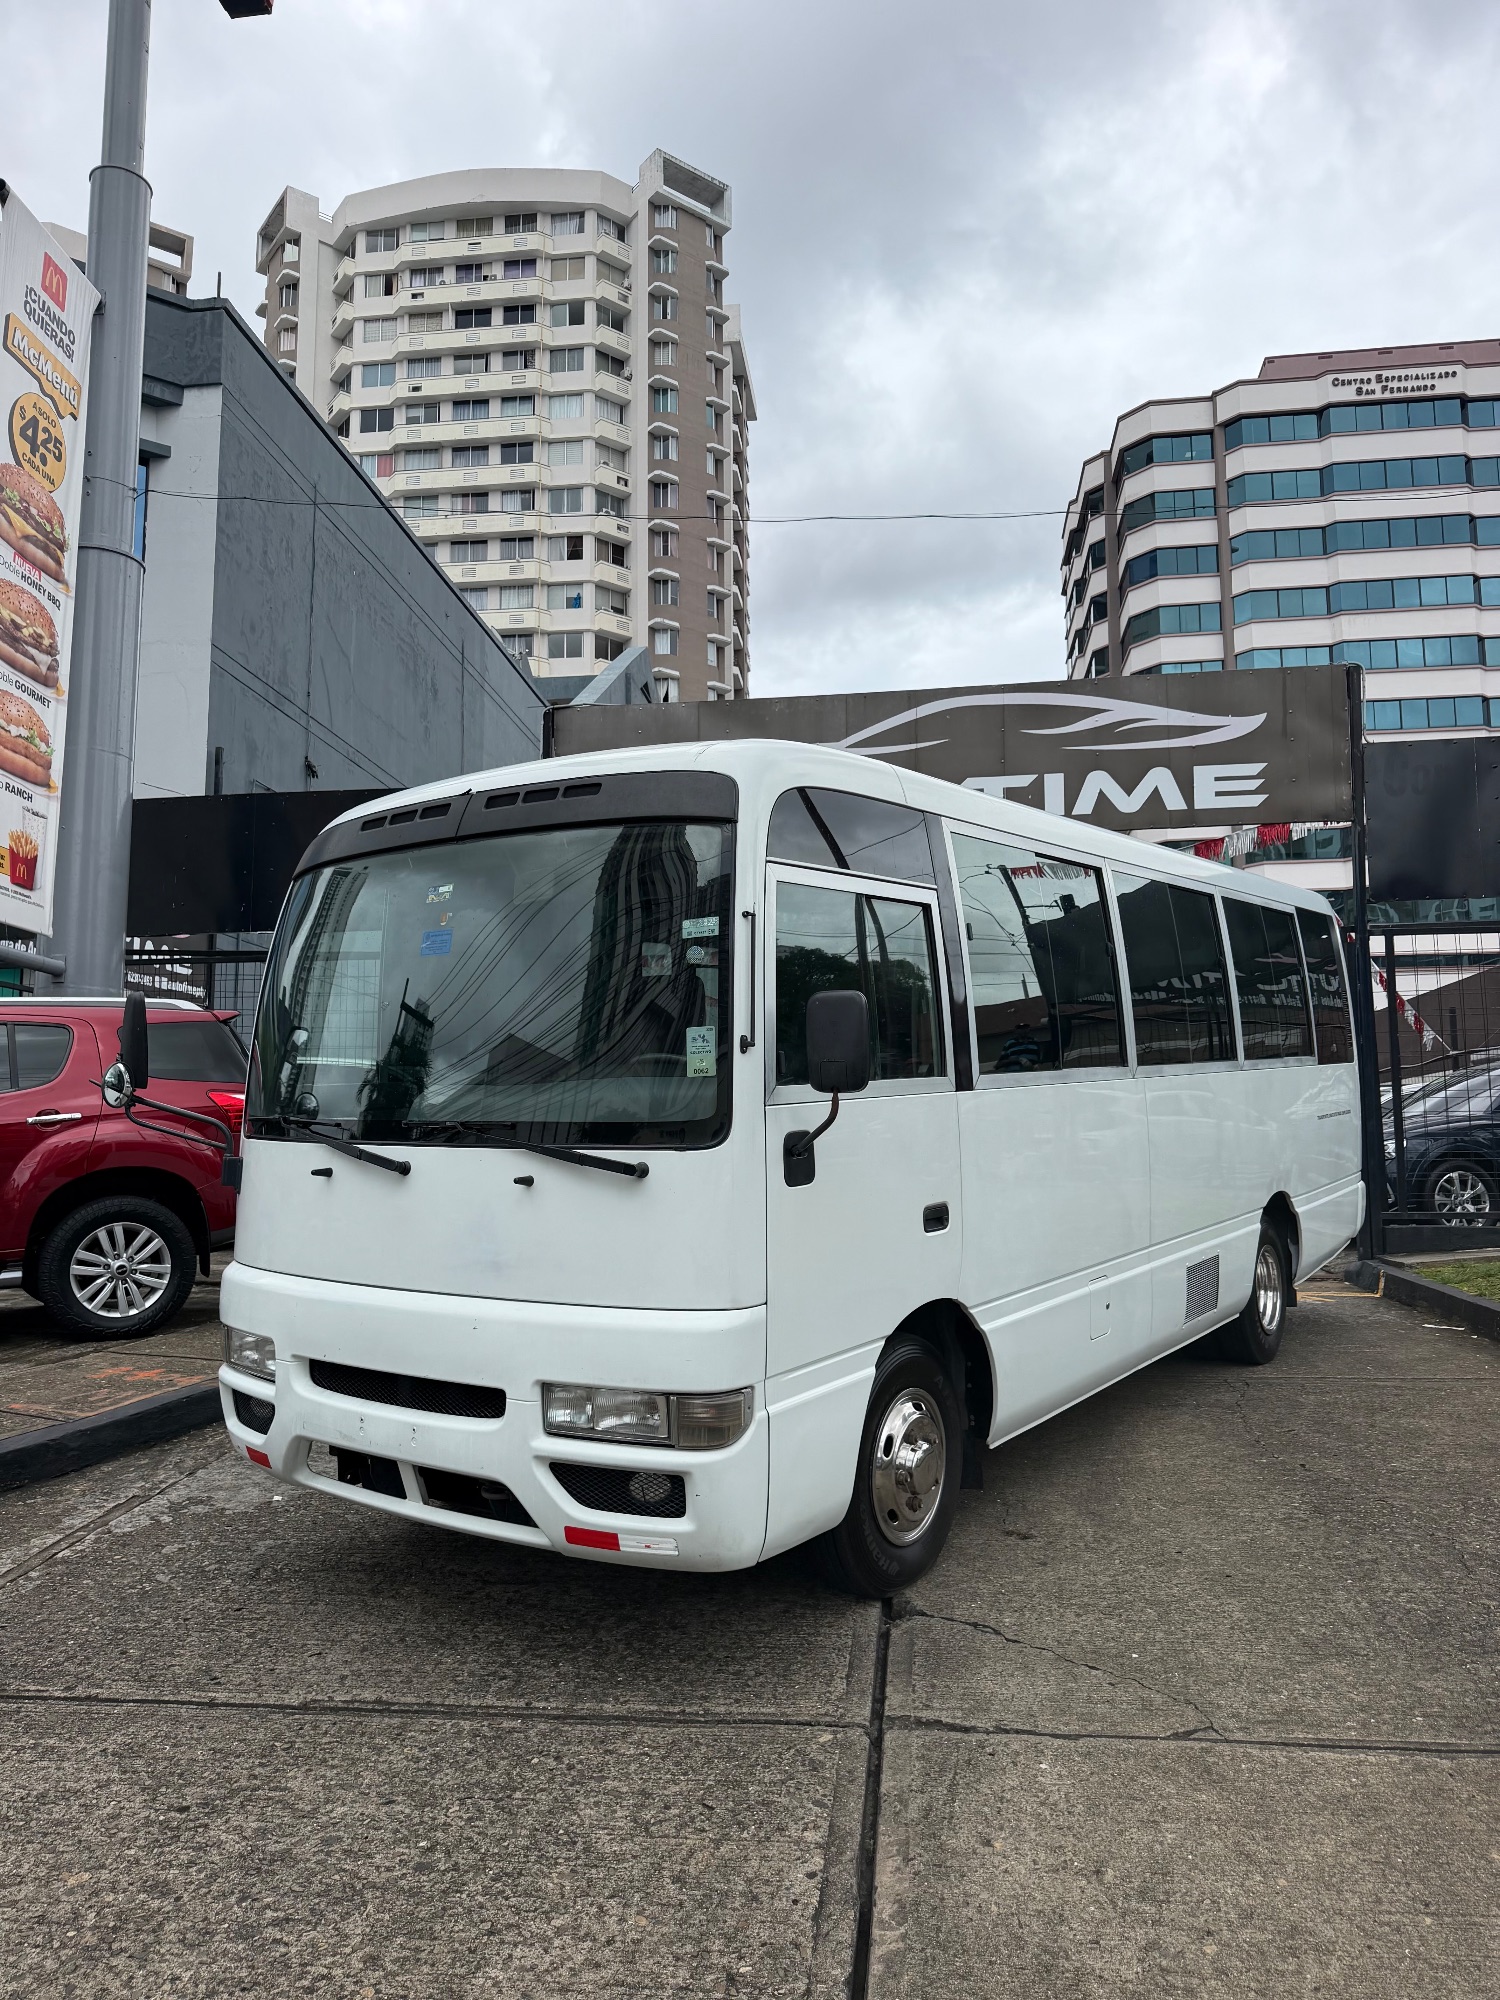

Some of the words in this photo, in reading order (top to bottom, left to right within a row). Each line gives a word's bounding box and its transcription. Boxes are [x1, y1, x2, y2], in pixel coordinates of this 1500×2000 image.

[23, 299, 75, 363] QUIERAS!
[24, 284, 76, 345] ¡CUANDO
[12, 326, 78, 410] McMenú
[32, 401, 38, 412] A
[37, 406, 57, 428] SOLO
[21, 452, 41, 474] CADA
[41, 469, 56, 488] UNA
[14, 553, 41, 581] NUEVA
[21, 571, 47, 597] HONEY
[47, 591, 61, 612] BBQ
[0, 671, 14, 687] oble
[14, 679, 52, 709] GOURMET
[5, 781, 33, 803] RANCH
